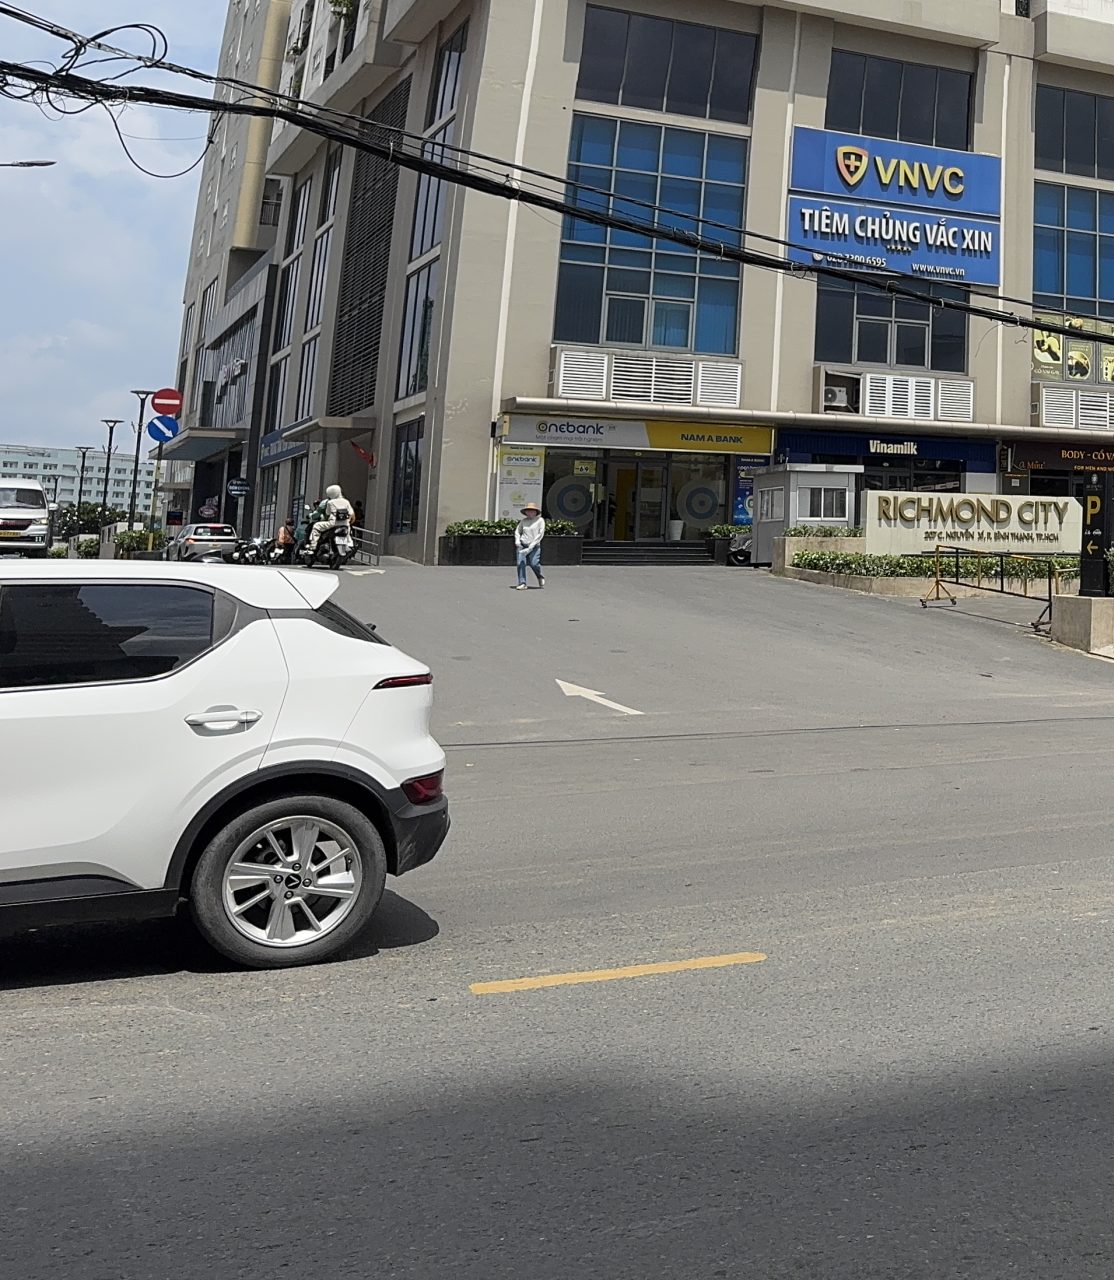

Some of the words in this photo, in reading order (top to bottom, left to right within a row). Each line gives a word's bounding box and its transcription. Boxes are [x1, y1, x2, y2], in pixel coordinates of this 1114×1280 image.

[875, 156, 965, 194] VNVC
[801, 206, 849, 235] TIÊM
[854, 211, 920, 243] CHỦNG
[925, 218, 958, 247] VẮC
[963, 228, 992, 251] XIN
[866, 256, 887, 267] 6595
[912, 263, 965, 276] www.vnvc.vn
[869, 440, 918, 456] Vinamilk
[1061, 450, 1086, 459] BODY
[877, 495, 1013, 524] RICHMOND
[1017, 501, 1069, 525] CITY
[1086, 495, 1101, 525] P
